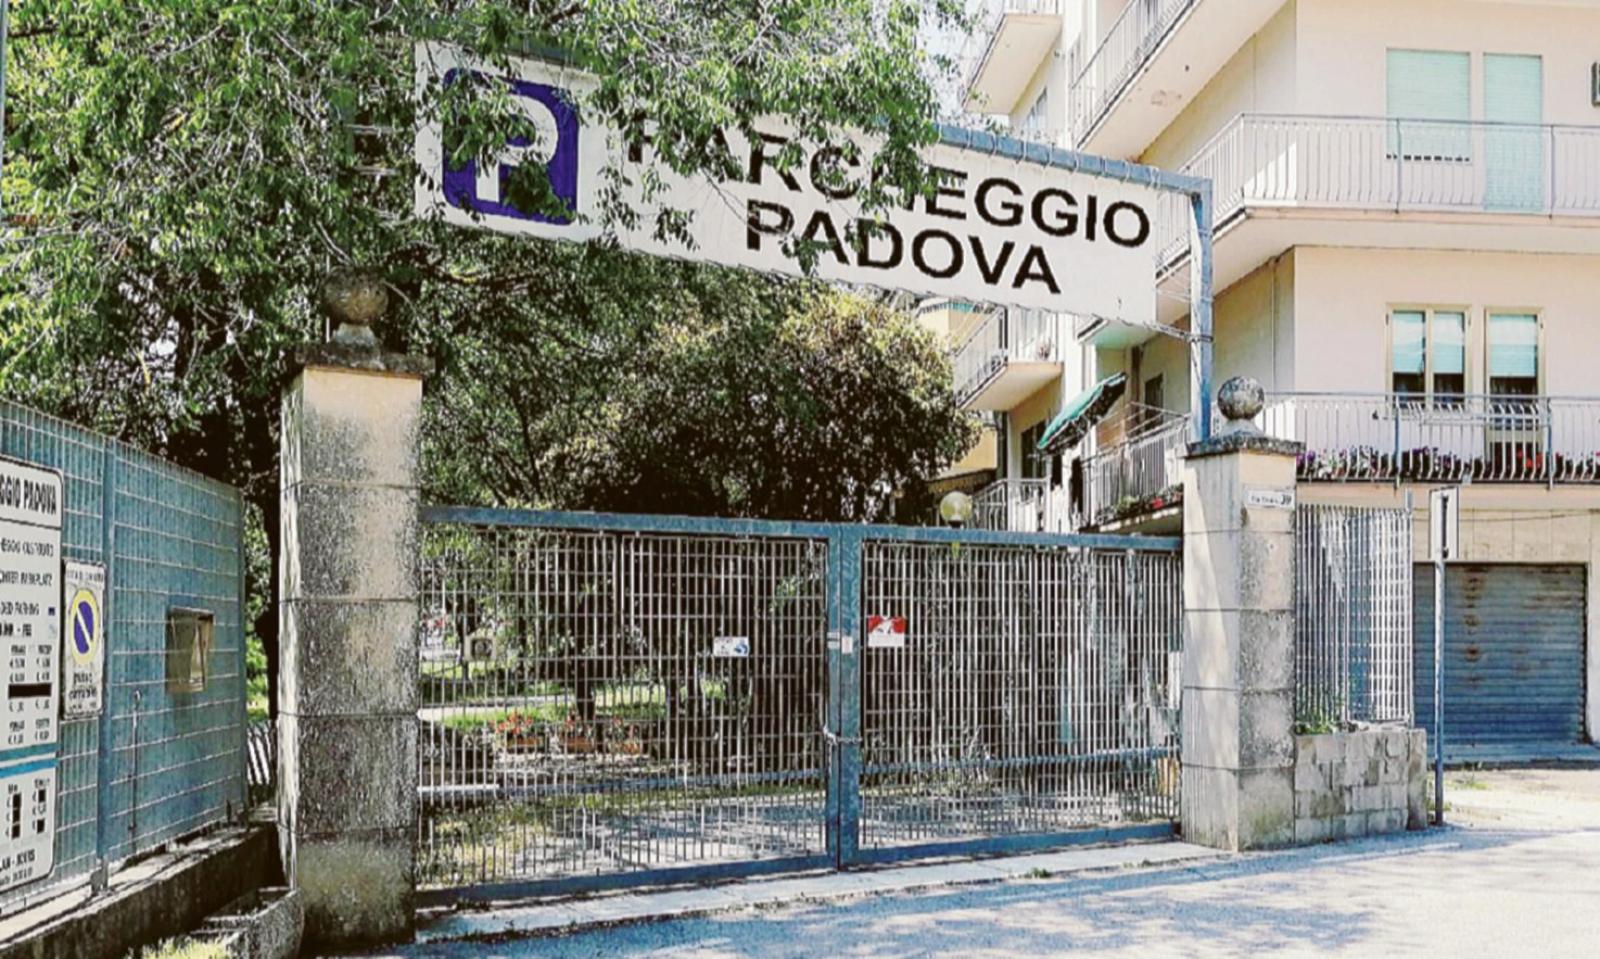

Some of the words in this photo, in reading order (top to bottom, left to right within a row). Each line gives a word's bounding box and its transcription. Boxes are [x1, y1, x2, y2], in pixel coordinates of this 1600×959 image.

[474, 91, 559, 204] P
[747, 198, 1062, 295] PADOVA
[23, 479, 57, 515] PADOVA
